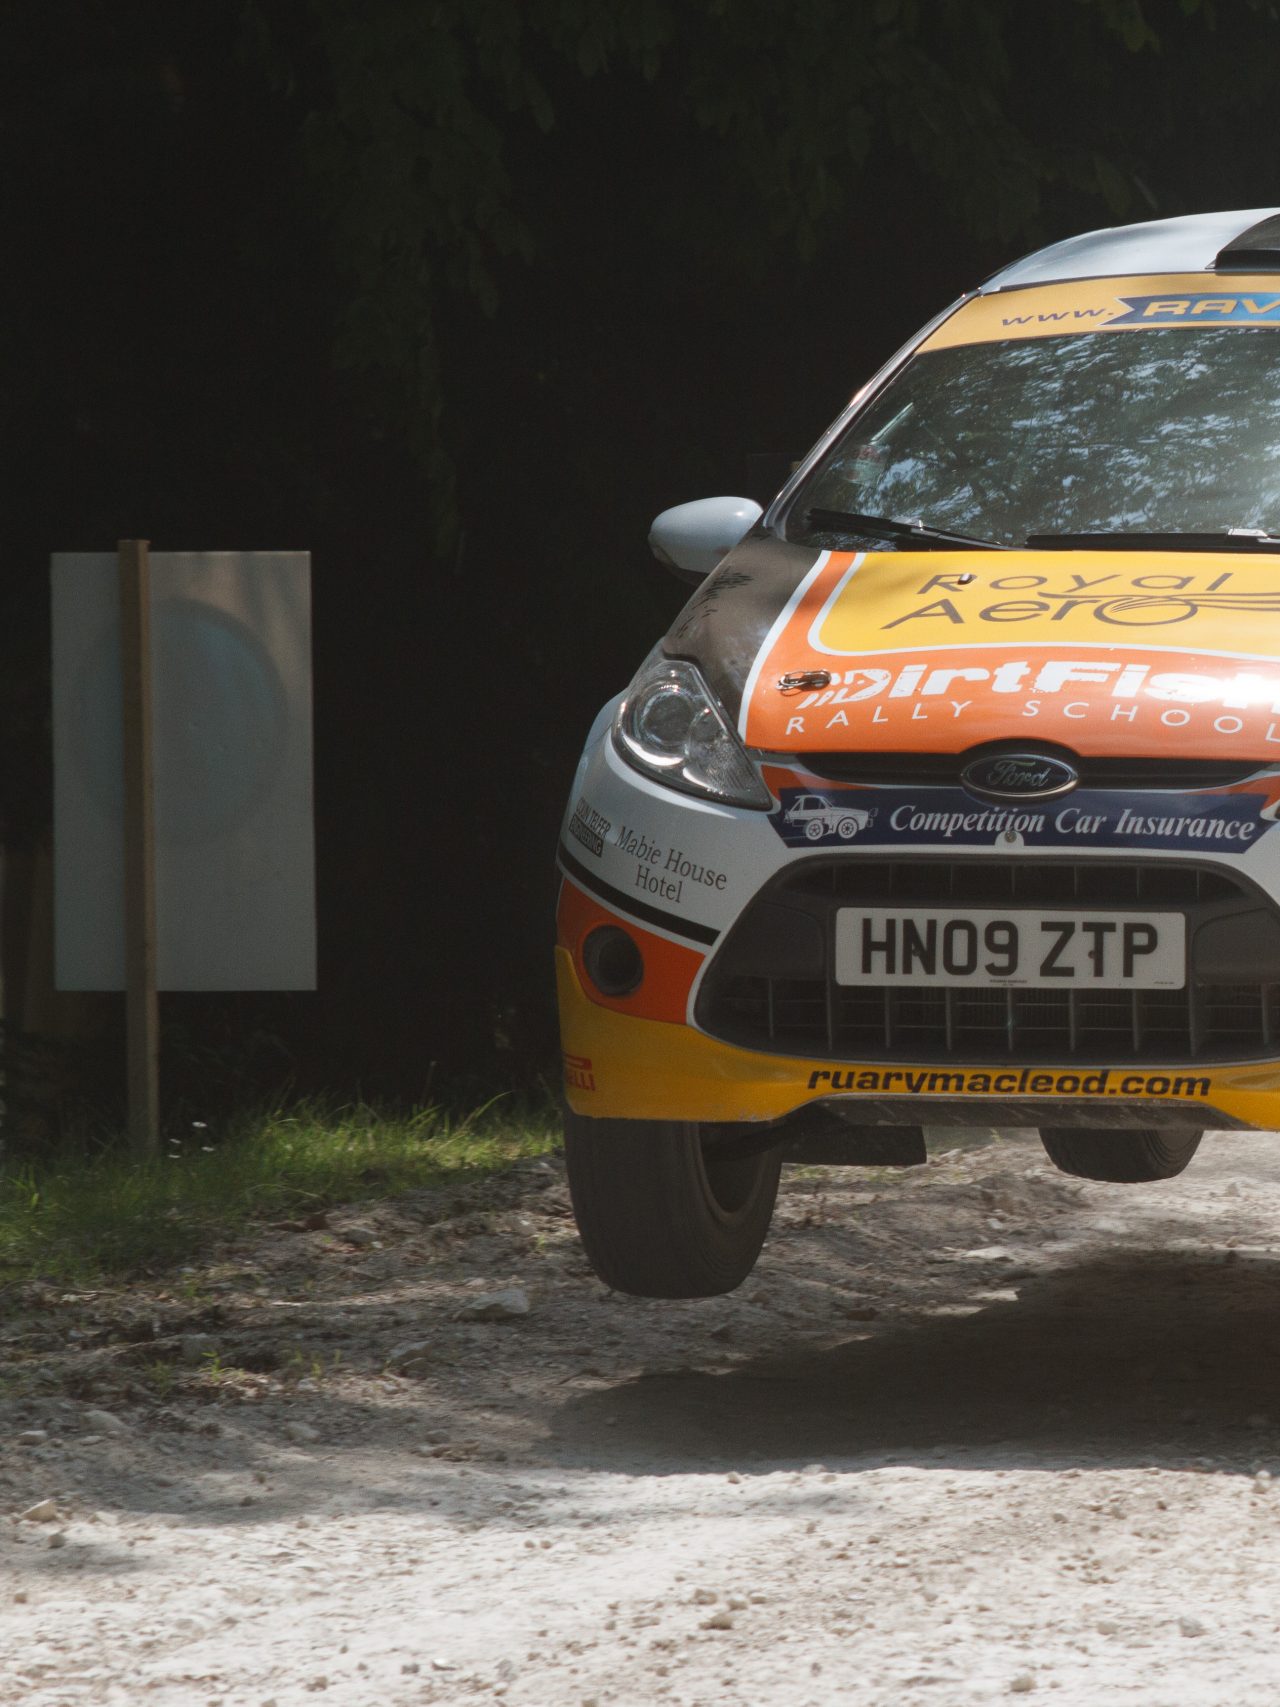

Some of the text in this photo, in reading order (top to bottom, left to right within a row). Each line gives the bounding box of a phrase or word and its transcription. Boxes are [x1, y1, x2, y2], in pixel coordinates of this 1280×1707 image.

[917, 572, 1234, 594] Royal
[880, 596, 1198, 630] Aero
[785, 700, 973, 735] RALLY
[985, 759, 1052, 788] Ford
[890, 805, 1256, 841] Competition Car Insurance
[613, 825, 662, 866] Mabie
[663, 847, 728, 891] House
[634, 864, 684, 904] Hotel
[861, 918, 1159, 979] HN09 ZTP
[807, 1068, 1212, 1097] ruarymacleod.com
